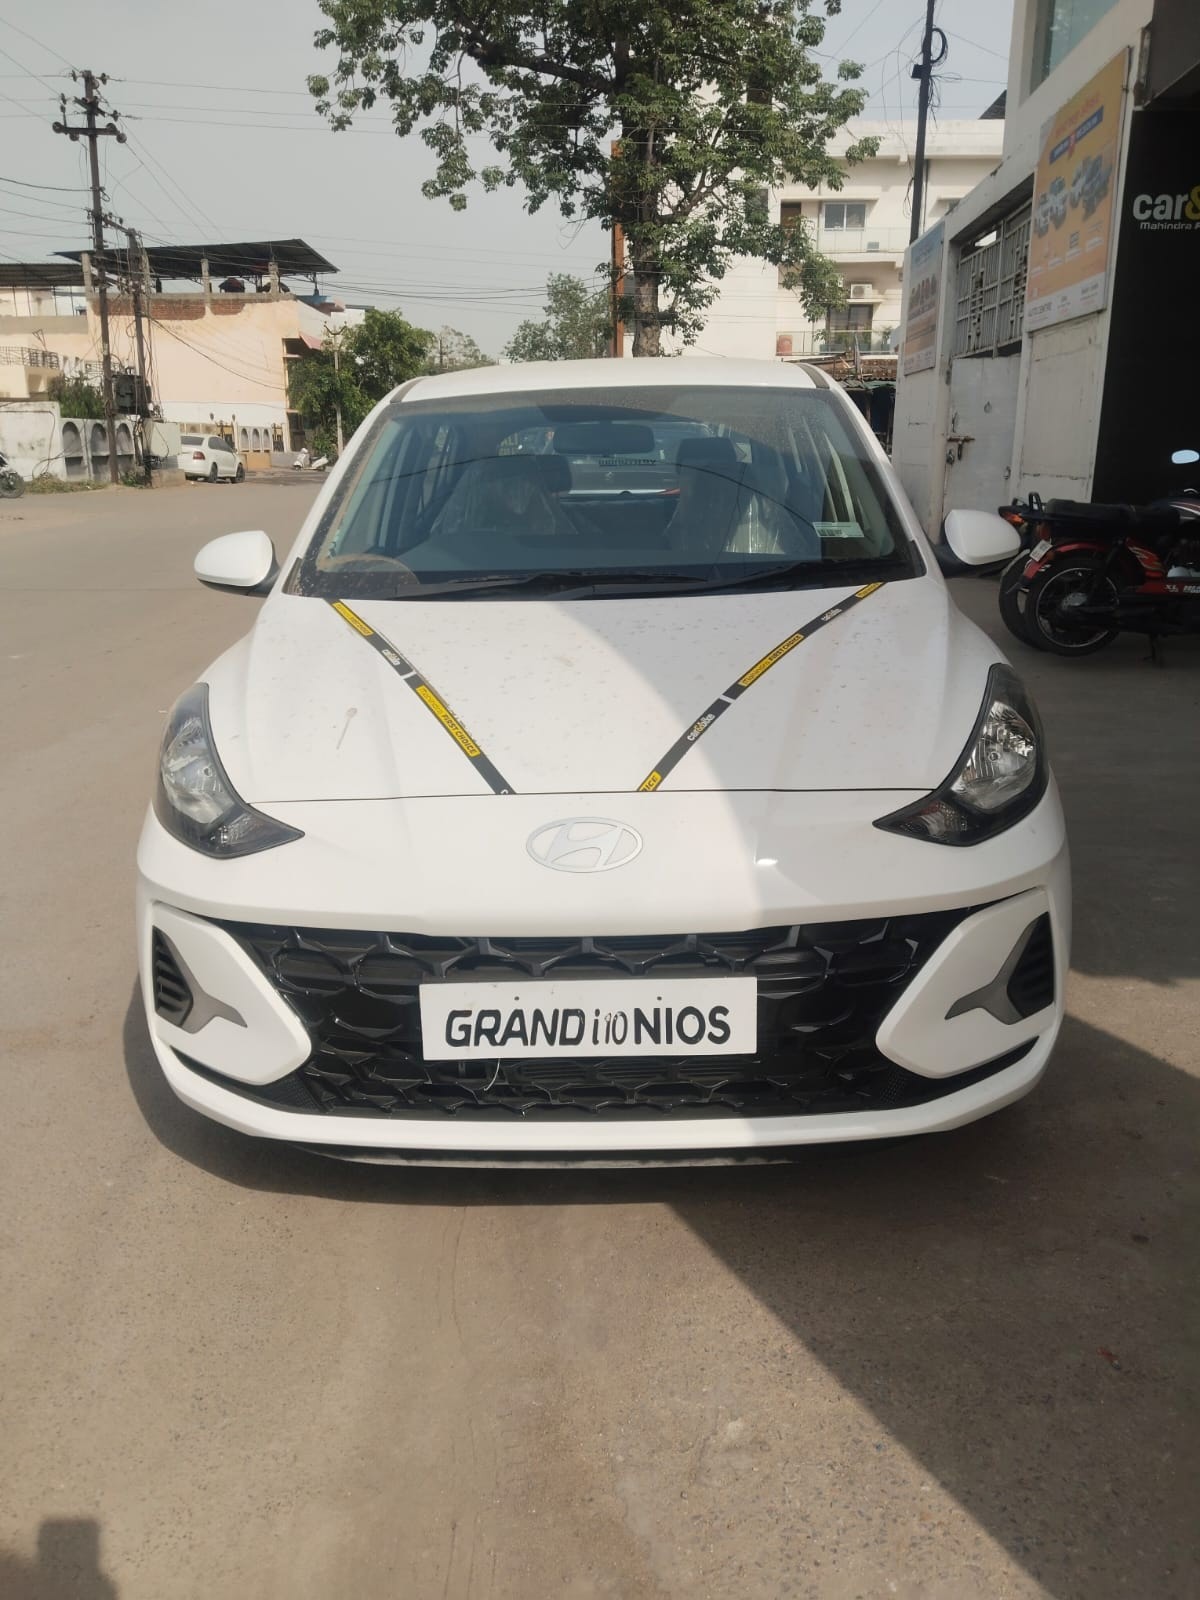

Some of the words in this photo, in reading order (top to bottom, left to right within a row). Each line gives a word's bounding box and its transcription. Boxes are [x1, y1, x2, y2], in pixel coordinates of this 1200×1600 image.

[445, 1008, 586, 1047] GRAND
[592, 1008, 629, 1046] i10
[634, 1006, 731, 1045] NIOS
